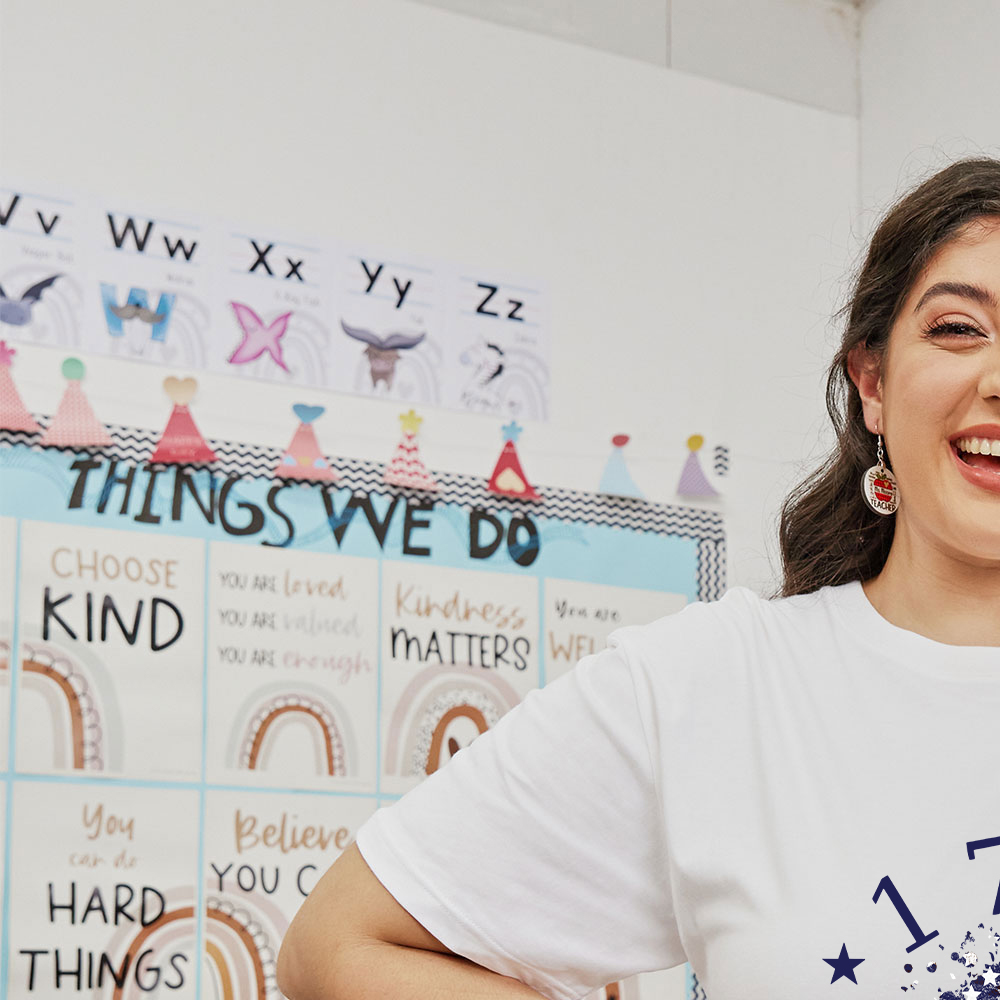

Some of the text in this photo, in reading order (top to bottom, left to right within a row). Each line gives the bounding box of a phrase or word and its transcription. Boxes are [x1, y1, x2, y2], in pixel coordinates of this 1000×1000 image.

[68, 459, 541, 567] THINGS WE DO
[51, 547, 179, 589] CHOOSE
[219, 571, 248, 589] YOU
[283, 568, 347, 600] loved
[43, 586, 184, 651] KIND
[218, 608, 247, 627] YOU
[283, 605, 362, 638] valued
[395, 583, 526, 630] Kindness
[217, 646, 247, 664] YOU
[283, 650, 372, 686] enough
[83, 803, 135, 840] You
[235, 809, 349, 854] Believe
[69, 849, 138, 868] can do
[211, 862, 279, 894] YOU
[48, 882, 165, 927] HARD
[19, 949, 189, 992] THINGS
